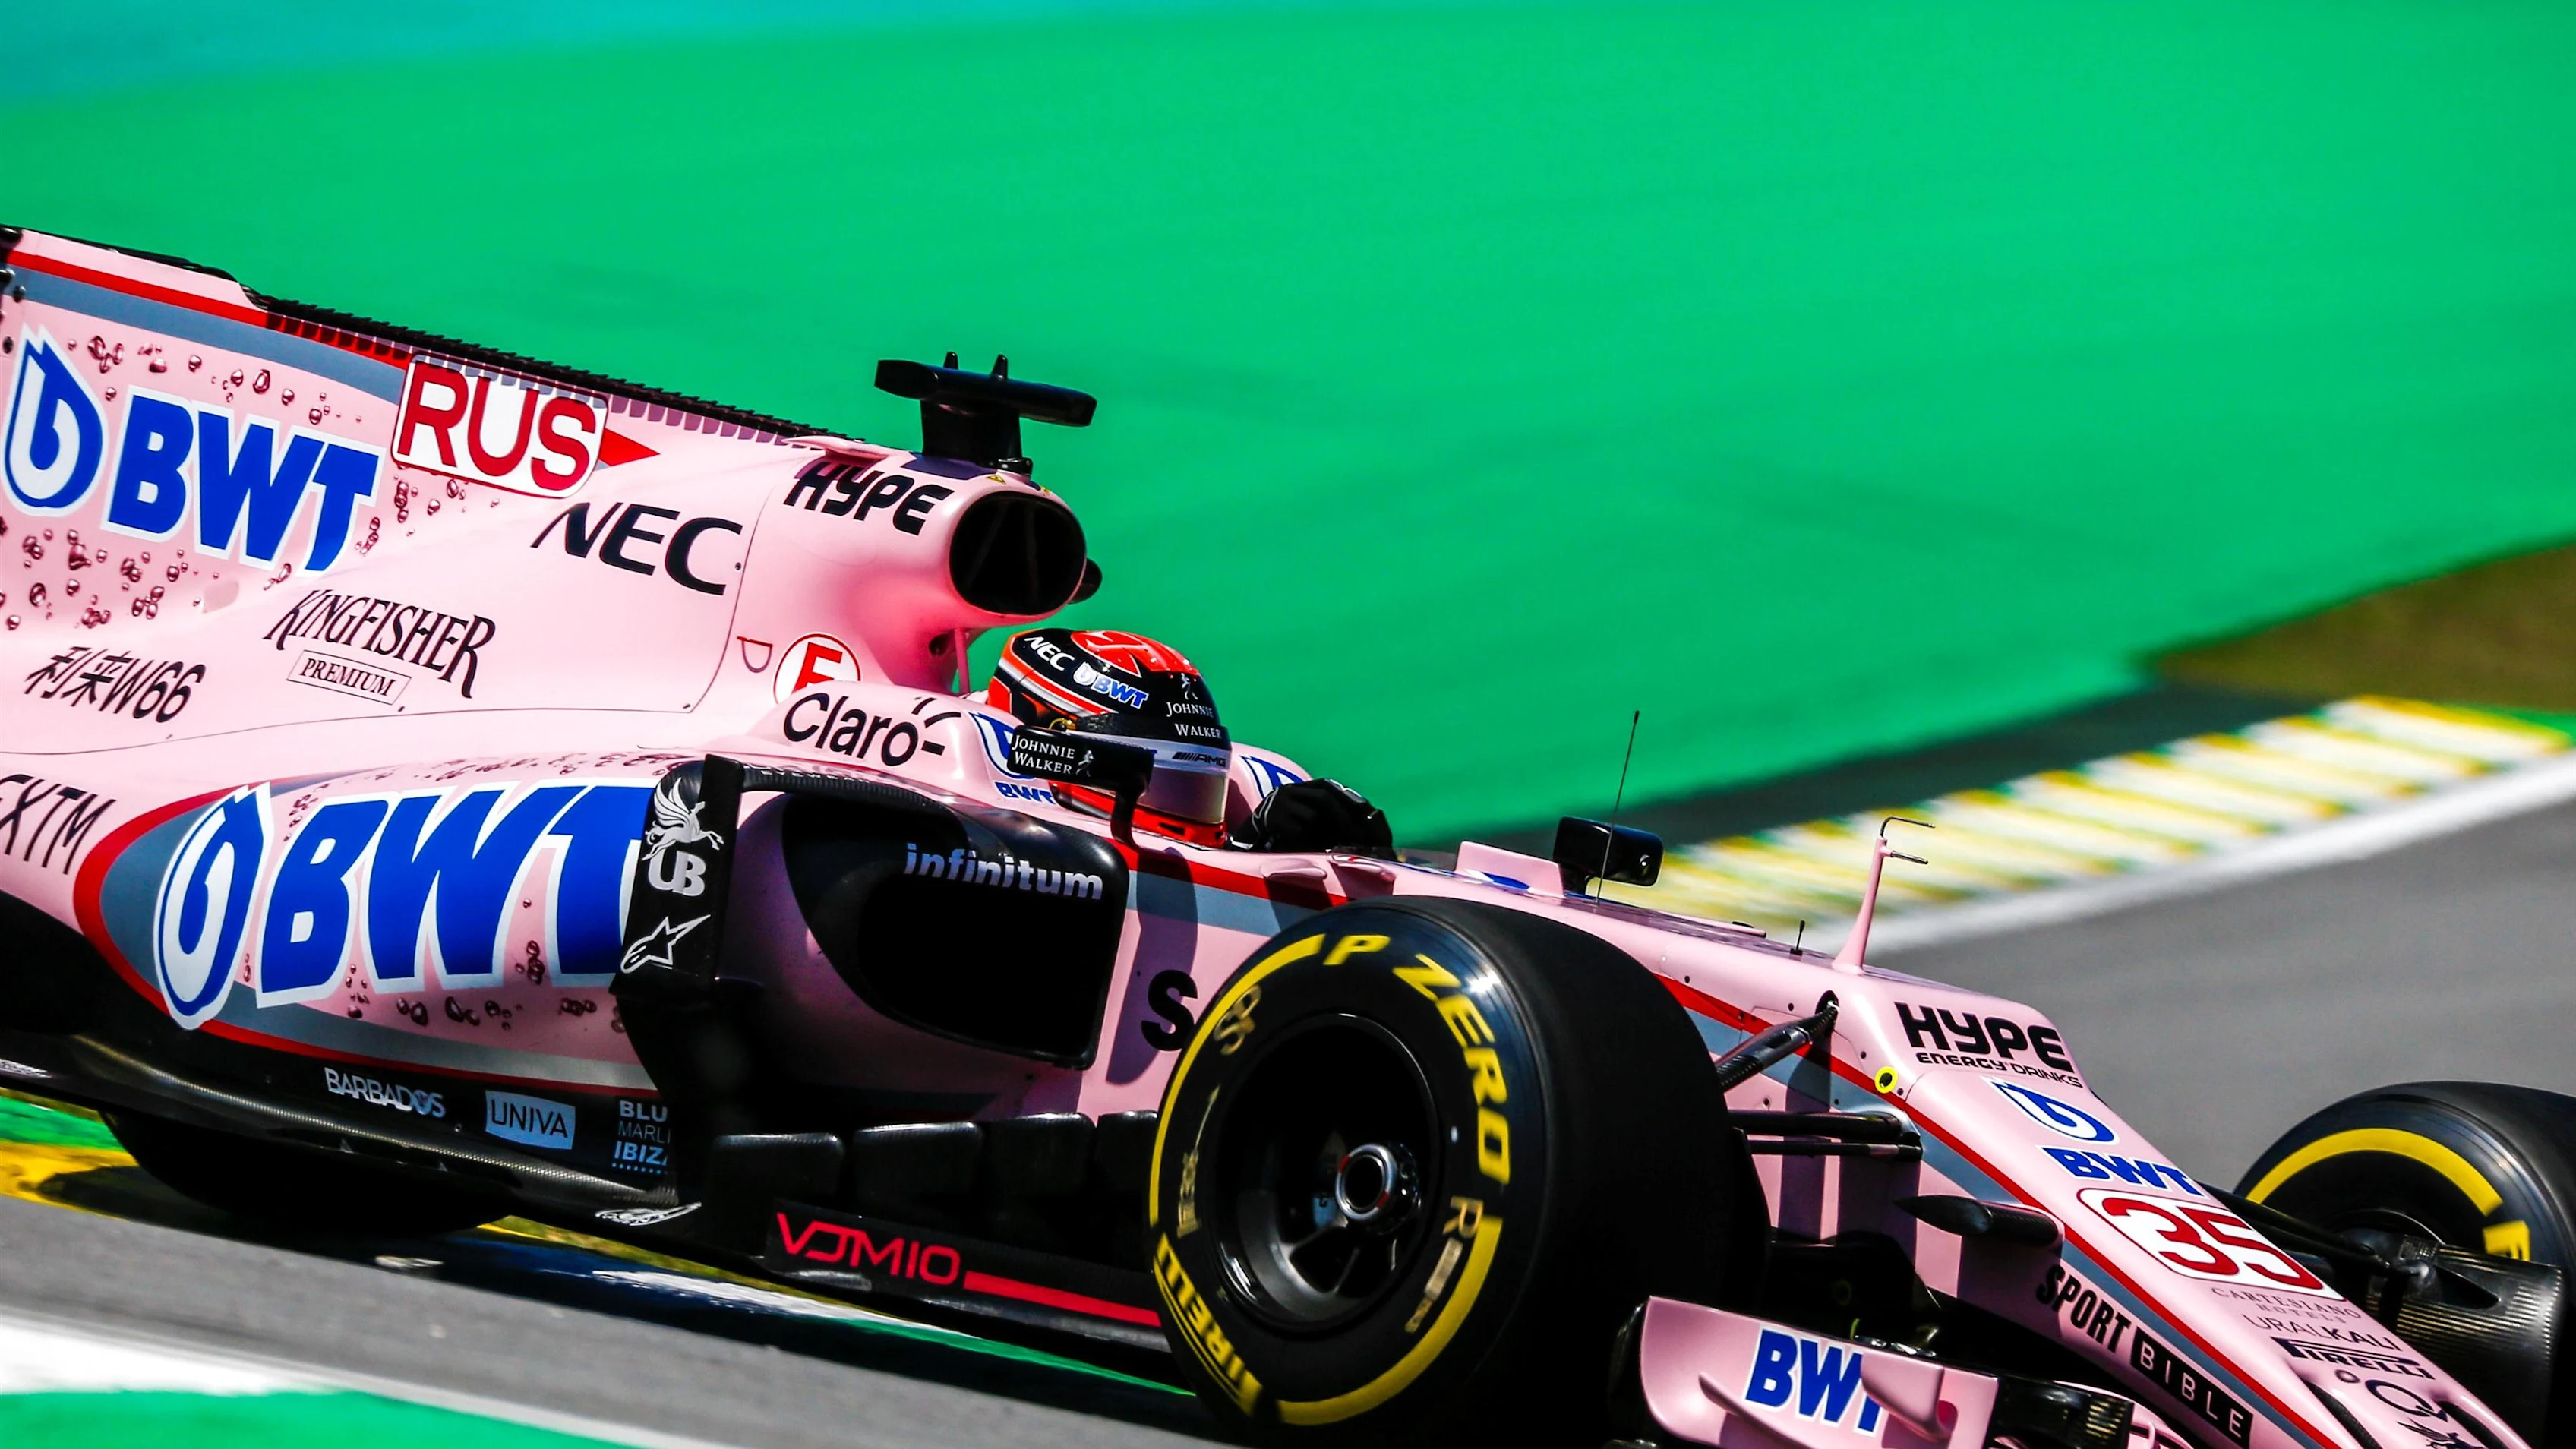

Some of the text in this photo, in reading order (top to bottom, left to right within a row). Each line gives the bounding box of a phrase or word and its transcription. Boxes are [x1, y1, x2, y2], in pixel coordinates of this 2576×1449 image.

[396, 355, 595, 492] RUS
[105, 390, 382, 573] BWT
[783, 460, 954, 536] HYPE
[529, 501, 743, 596] NEC
[261, 589, 496, 699] KINGFISHER
[1024, 636, 1075, 671] NEC
[298, 658, 396, 696] PREMIUM
[1092, 674, 1148, 709] BWT
[783, 692, 919, 767] Claro
[1166, 701, 1214, 718] JOHNNIE
[1174, 722, 1222, 739] WALKER
[1012, 734, 1076, 759] JOHNNIE
[1014, 750, 1072, 775] WALKER
[994, 781, 1056, 805] BWT
[261, 784, 655, 993] BWT
[904, 843, 1103, 900] infinitum
[1324, 933, 1391, 966] P
[1392, 952, 1511, 1185] ZERO
[1893, 1000, 2076, 1074] HYPE
[324, 1066, 447, 1119] BARBADOS
[1915, 1051, 2085, 1089] ENERGY DRINKS
[491, 1099, 570, 1139] UNIVA
[617, 1119, 671, 1146] MARLI
[619, 1101, 668, 1123] BLU
[614, 1139, 668, 1167] IBIZ
[2039, 1146, 2206, 1198] BWT
[776, 1212, 962, 1285] VJM10
[2101, 1196, 2325, 1290] 35
[1152, 1231, 1264, 1419] PIRELLI
[2211, 1286, 2362, 1319] CARTESIANO
[2035, 1264, 2244, 1439] SPORT BIBLE
[2242, 1313, 2404, 1352] URALKALI
[2270, 1335, 2436, 1381] PIRELLI
